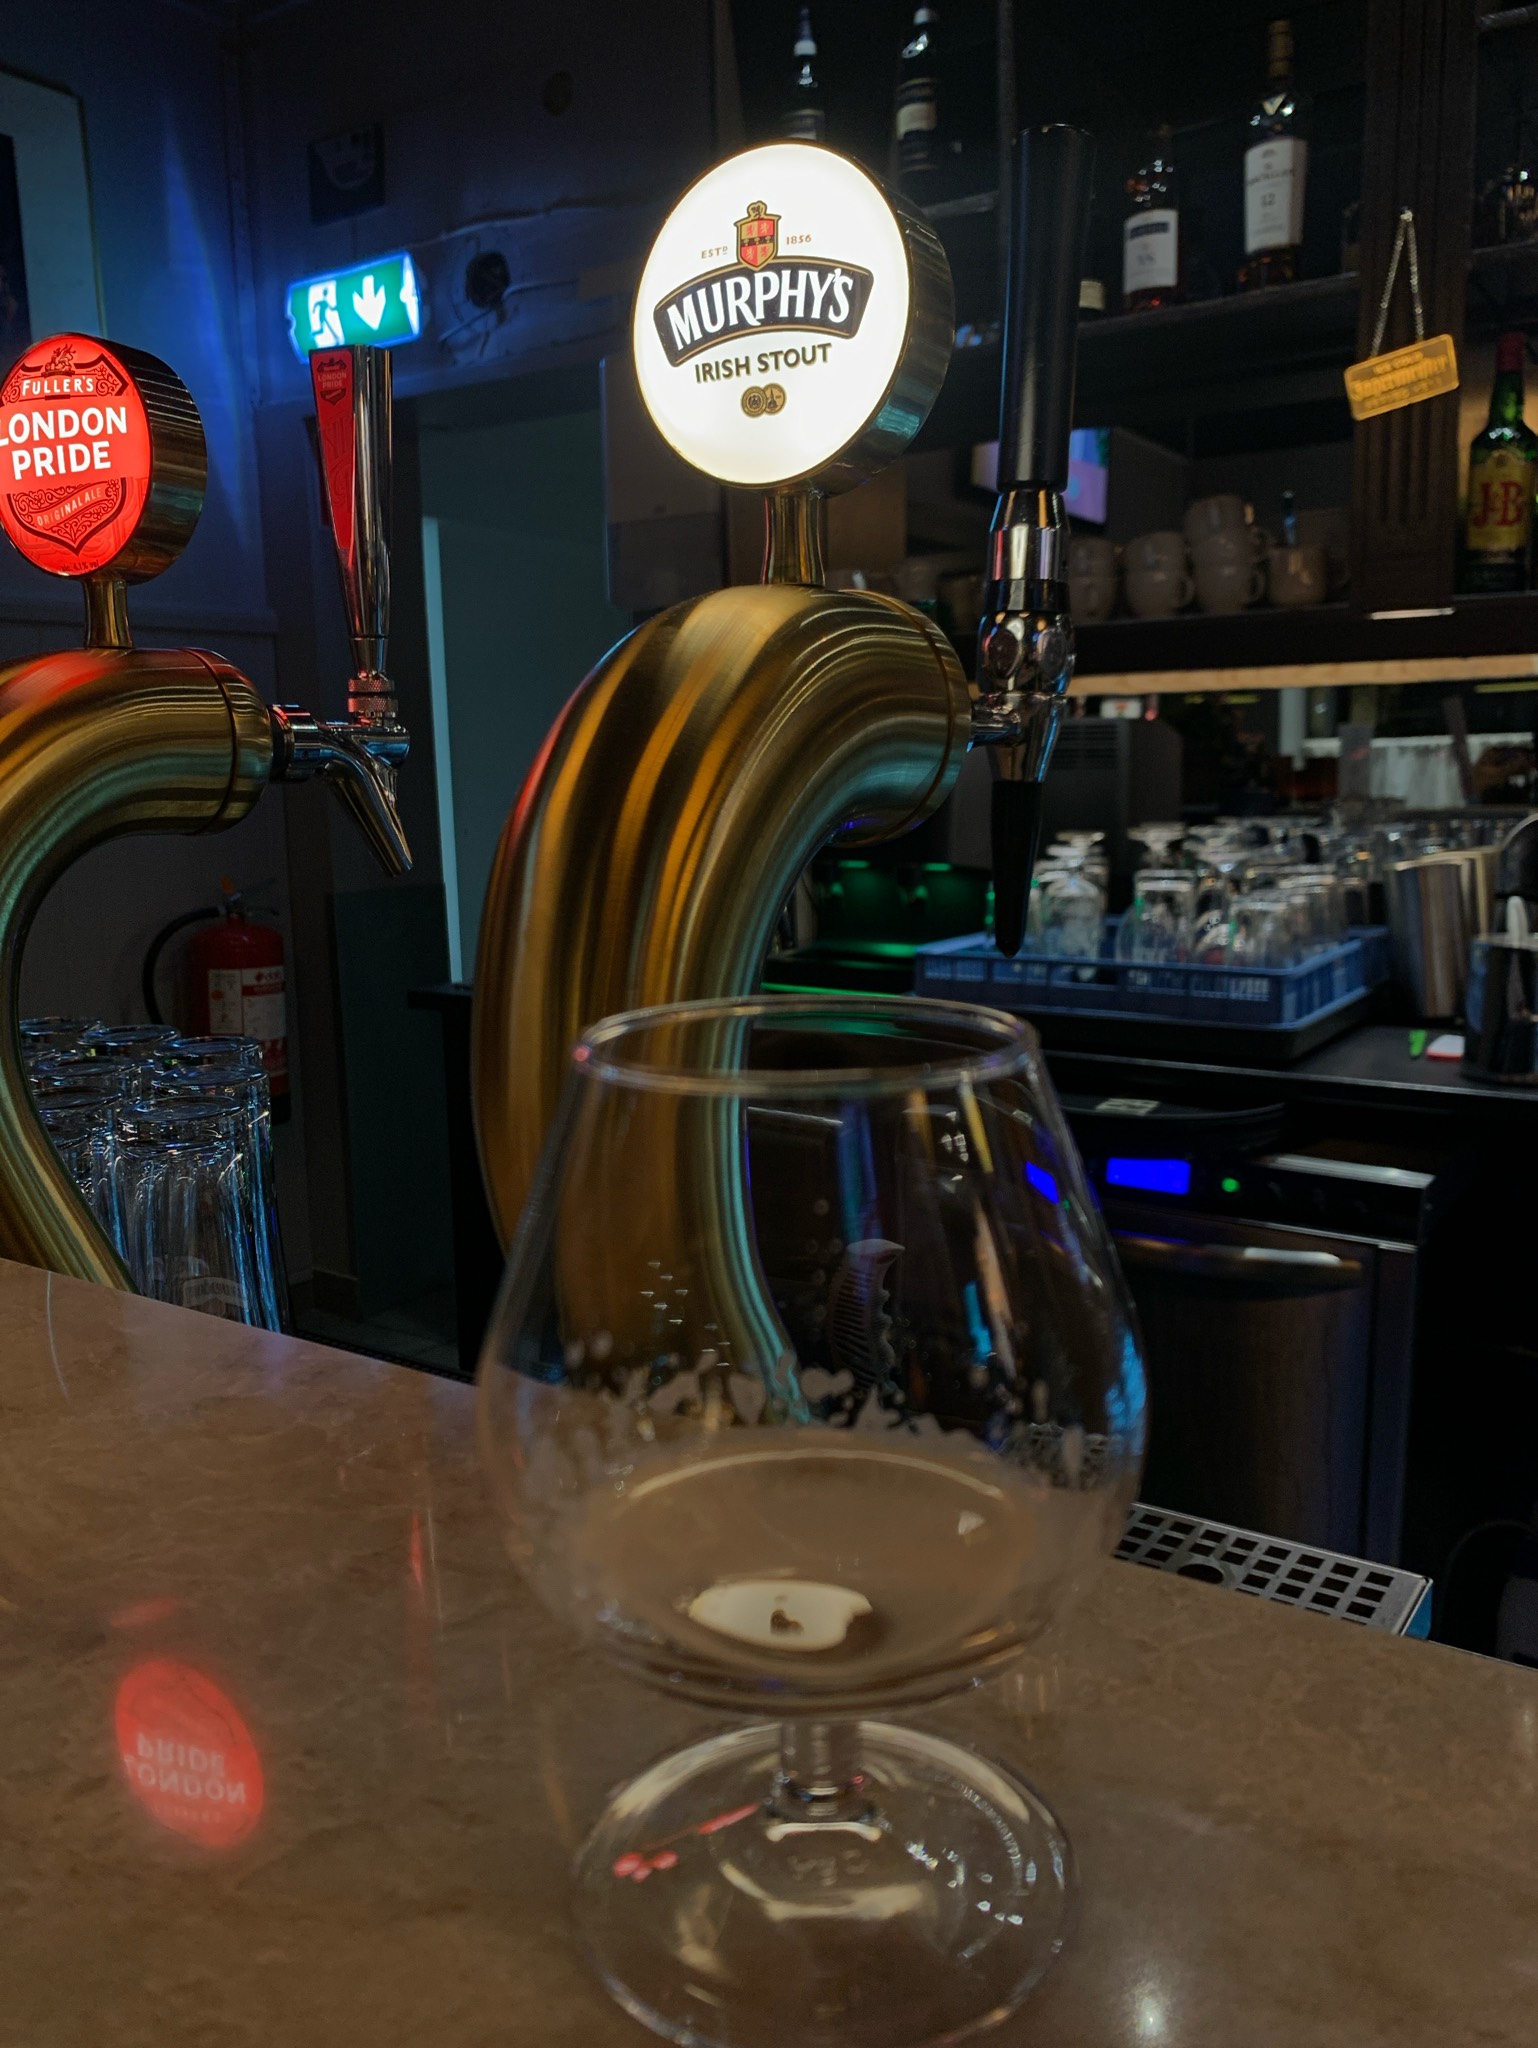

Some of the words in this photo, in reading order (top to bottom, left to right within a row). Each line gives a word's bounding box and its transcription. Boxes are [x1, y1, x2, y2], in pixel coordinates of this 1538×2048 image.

[786, 234, 812, 246] 1856
[666, 268, 854, 351] MURPHY'S
[317, 372, 347, 382] LONDON
[695, 355, 751, 384] IRISH
[757, 342, 832, 374] STOUT
[22, 375, 94, 396] FULLER'S
[322, 380, 343, 389] PRIDE
[12, 440, 111, 481] PRIDE
[36, 497, 83, 527] ORIGINAL
[84, 487, 101, 502] ALE
